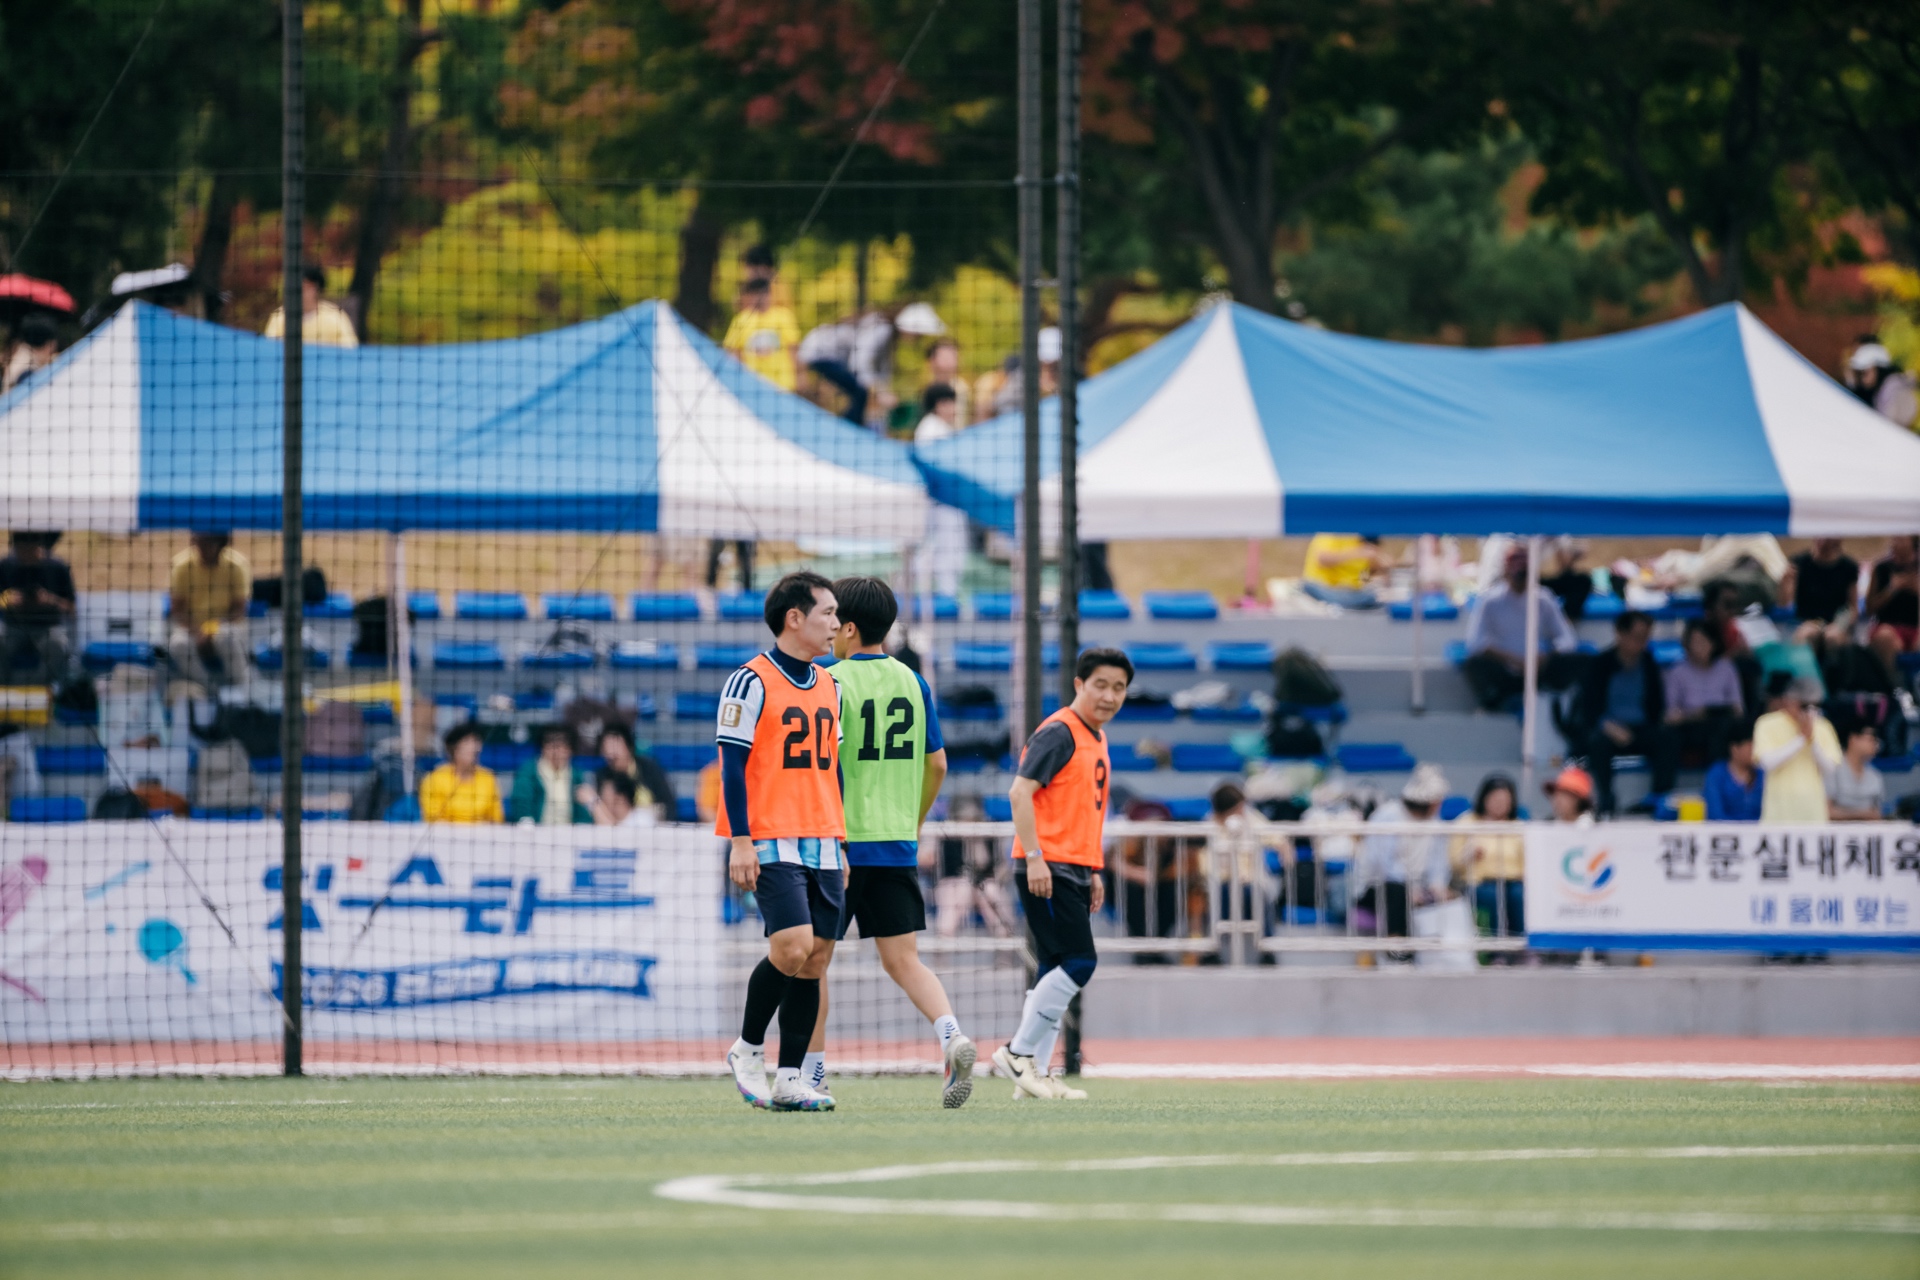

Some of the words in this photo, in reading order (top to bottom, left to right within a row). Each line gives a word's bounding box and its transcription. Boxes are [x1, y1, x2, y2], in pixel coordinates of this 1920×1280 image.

[782, 706, 834, 771] 20
[858, 697, 914, 761] 12
[1094, 758, 1108, 811] 9
[1658, 834, 1920, 882] 관문실내체육
[1750, 895, 1777, 924] 내
[1789, 896, 1844, 924] 몸에
[1856, 896, 1909, 924] 맞는
